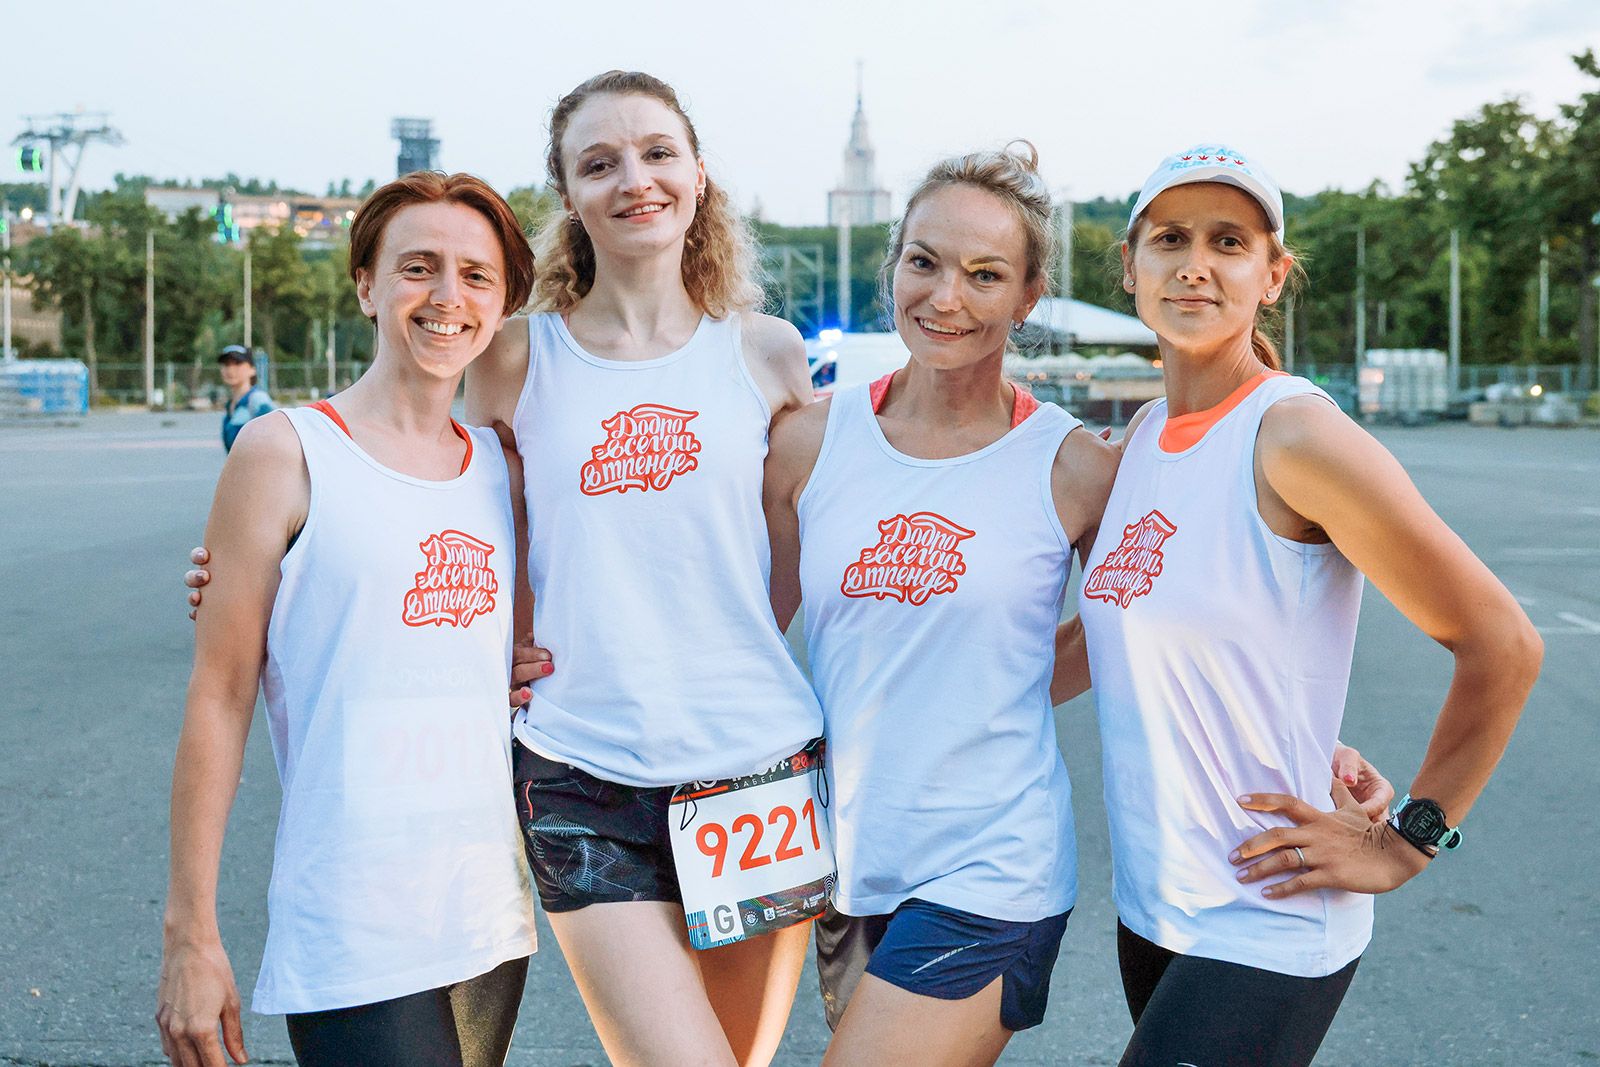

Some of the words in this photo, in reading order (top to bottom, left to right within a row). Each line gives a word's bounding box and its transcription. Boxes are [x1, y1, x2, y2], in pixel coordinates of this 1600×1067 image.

[594, 434, 701, 460] всегда
[602, 452, 697, 490] тренде
[862, 543, 965, 574] всегда
[417, 564, 497, 592] всегда
[864, 565, 956, 603] тренде
[423, 588, 494, 626] тренде
[733, 774, 774, 790] ЗАБЕГ
[695, 797, 821, 878] 9221
[713, 904, 735, 935] G
